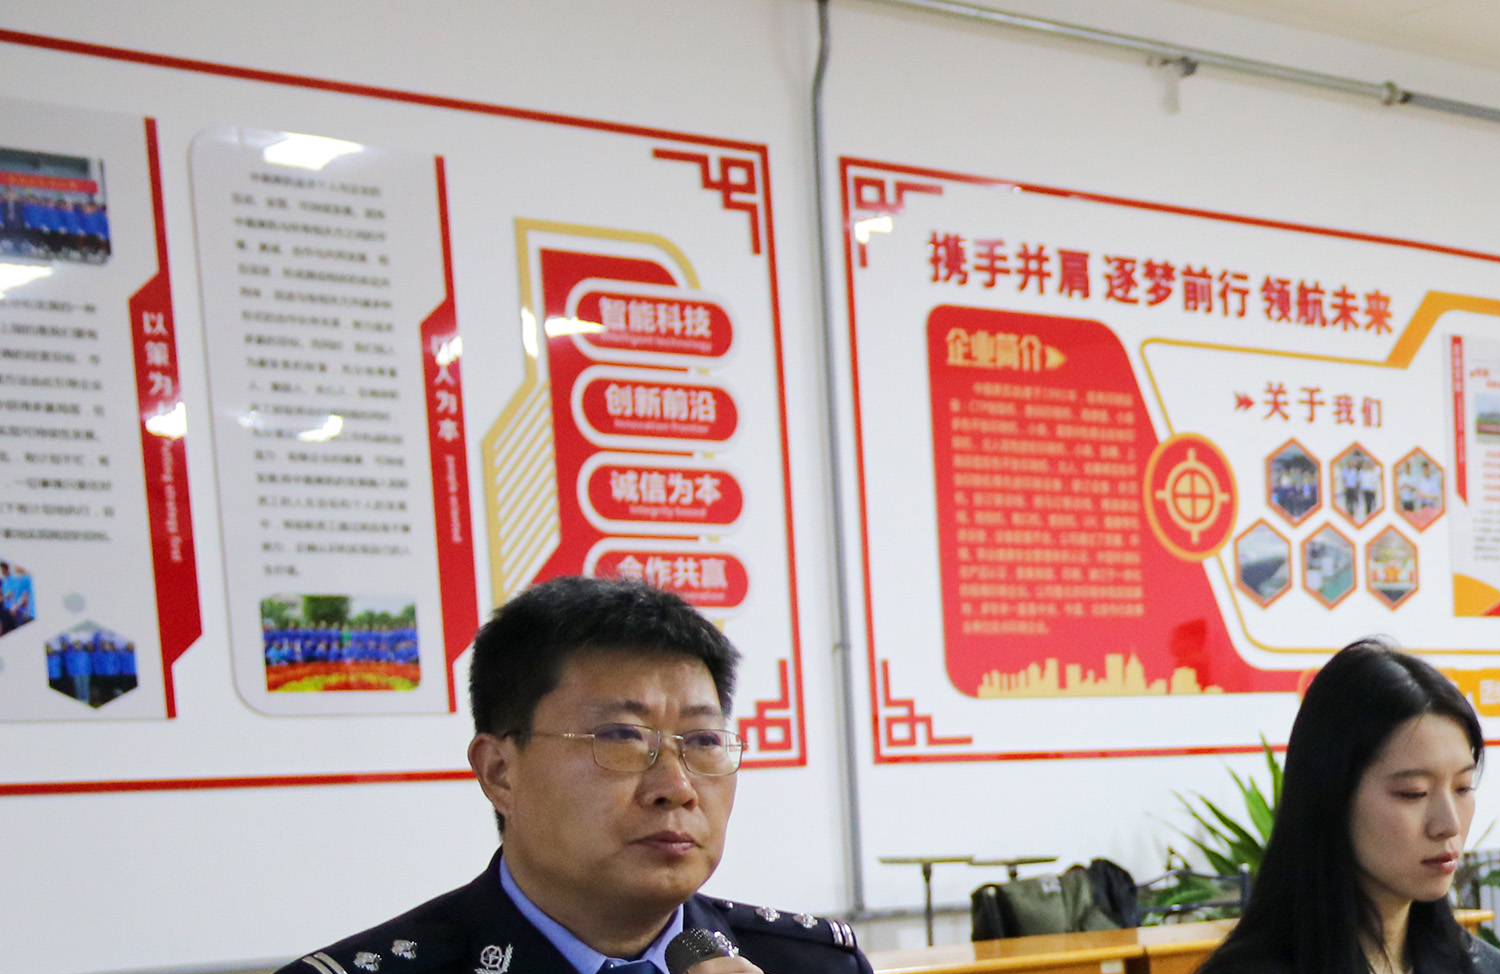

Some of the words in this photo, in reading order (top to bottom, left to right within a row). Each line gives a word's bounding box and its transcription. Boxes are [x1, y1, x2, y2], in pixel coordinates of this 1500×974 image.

[928, 231, 1091, 299] 携手并肩
[1104, 255, 1251, 318] 逐梦前行
[1260, 274, 1394, 336] 领航未来
[599, 296, 712, 337] 智能科技
[142, 311, 182, 420] 以策为
[605, 383, 717, 422] 创新前沿
[1263, 382, 1383, 428] 关于我们
[610, 470, 723, 505] 诚信为本
[616, 555, 728, 589] 合作共赢
